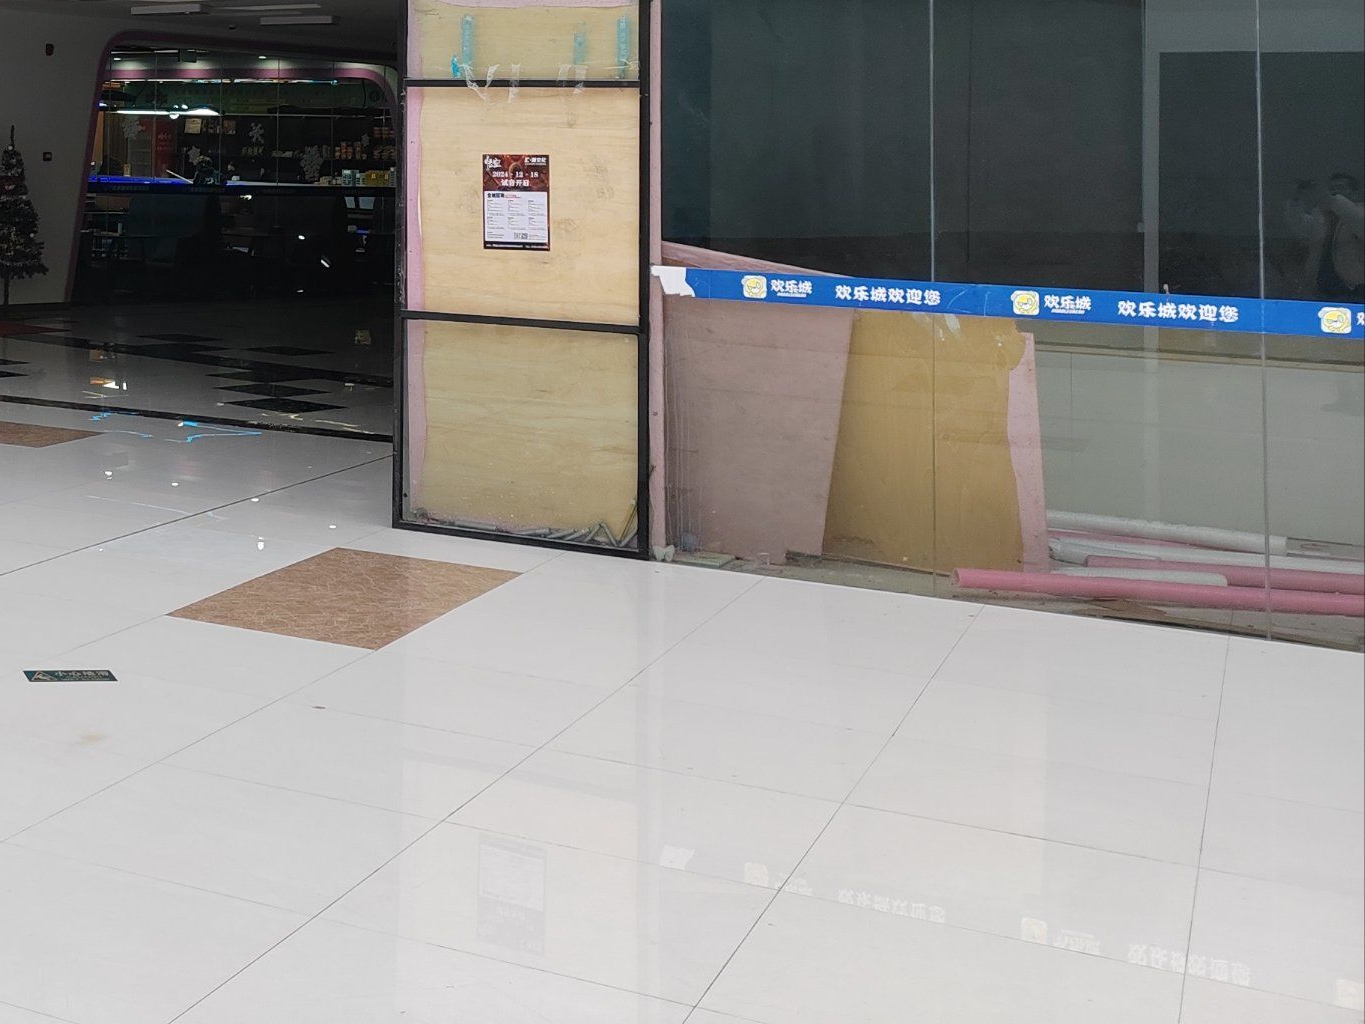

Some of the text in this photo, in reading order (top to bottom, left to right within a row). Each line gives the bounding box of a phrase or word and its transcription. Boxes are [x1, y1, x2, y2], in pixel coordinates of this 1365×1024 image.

[770, 279, 1239, 323] 欢乐城 欢乐城欢迎您 欢乐城 欢乐城欢迎您
